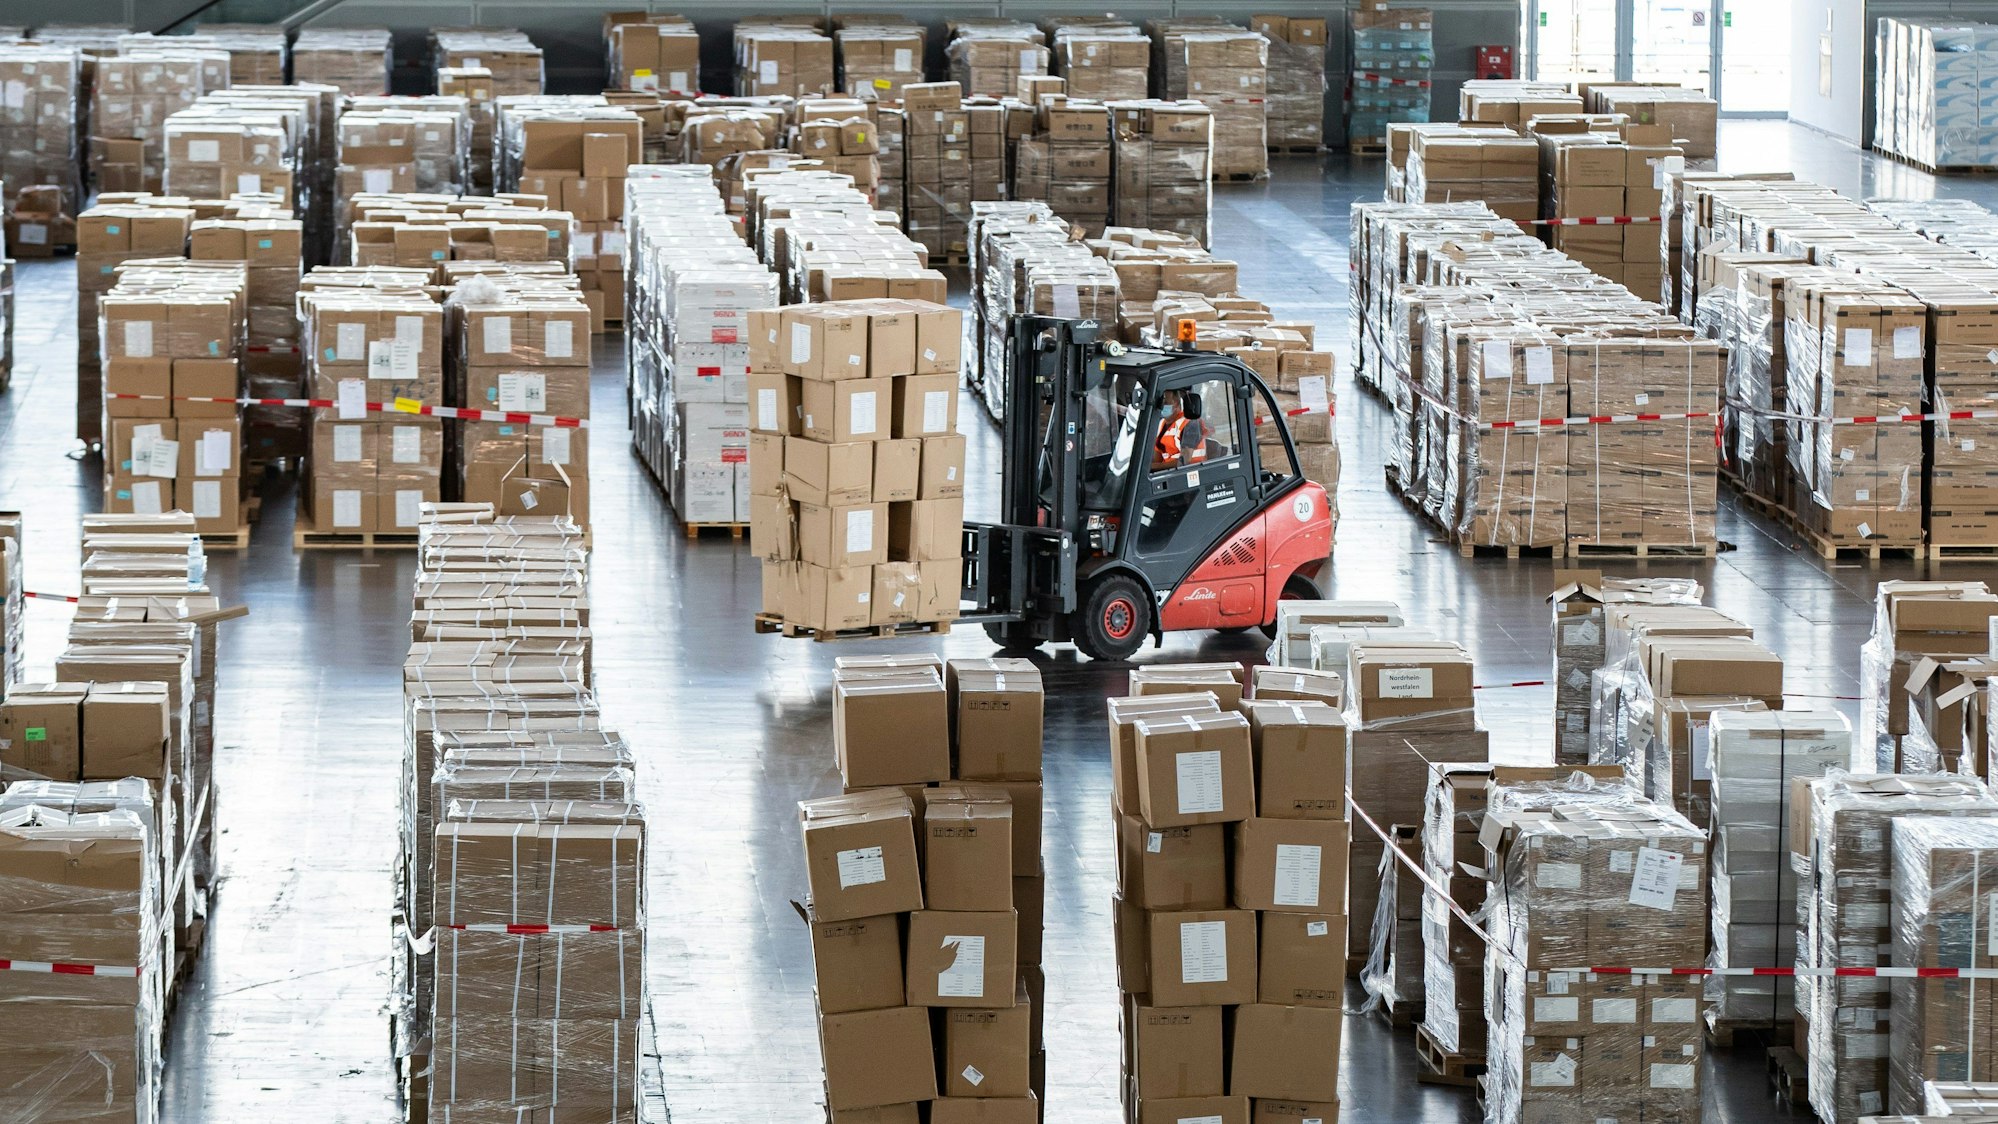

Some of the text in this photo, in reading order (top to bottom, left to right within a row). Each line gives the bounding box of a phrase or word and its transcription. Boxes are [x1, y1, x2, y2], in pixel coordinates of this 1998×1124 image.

[1076, 320, 1098, 329] Linde
[1298, 502, 1309, 513] 20
[1184, 587, 1216, 600] Linde
